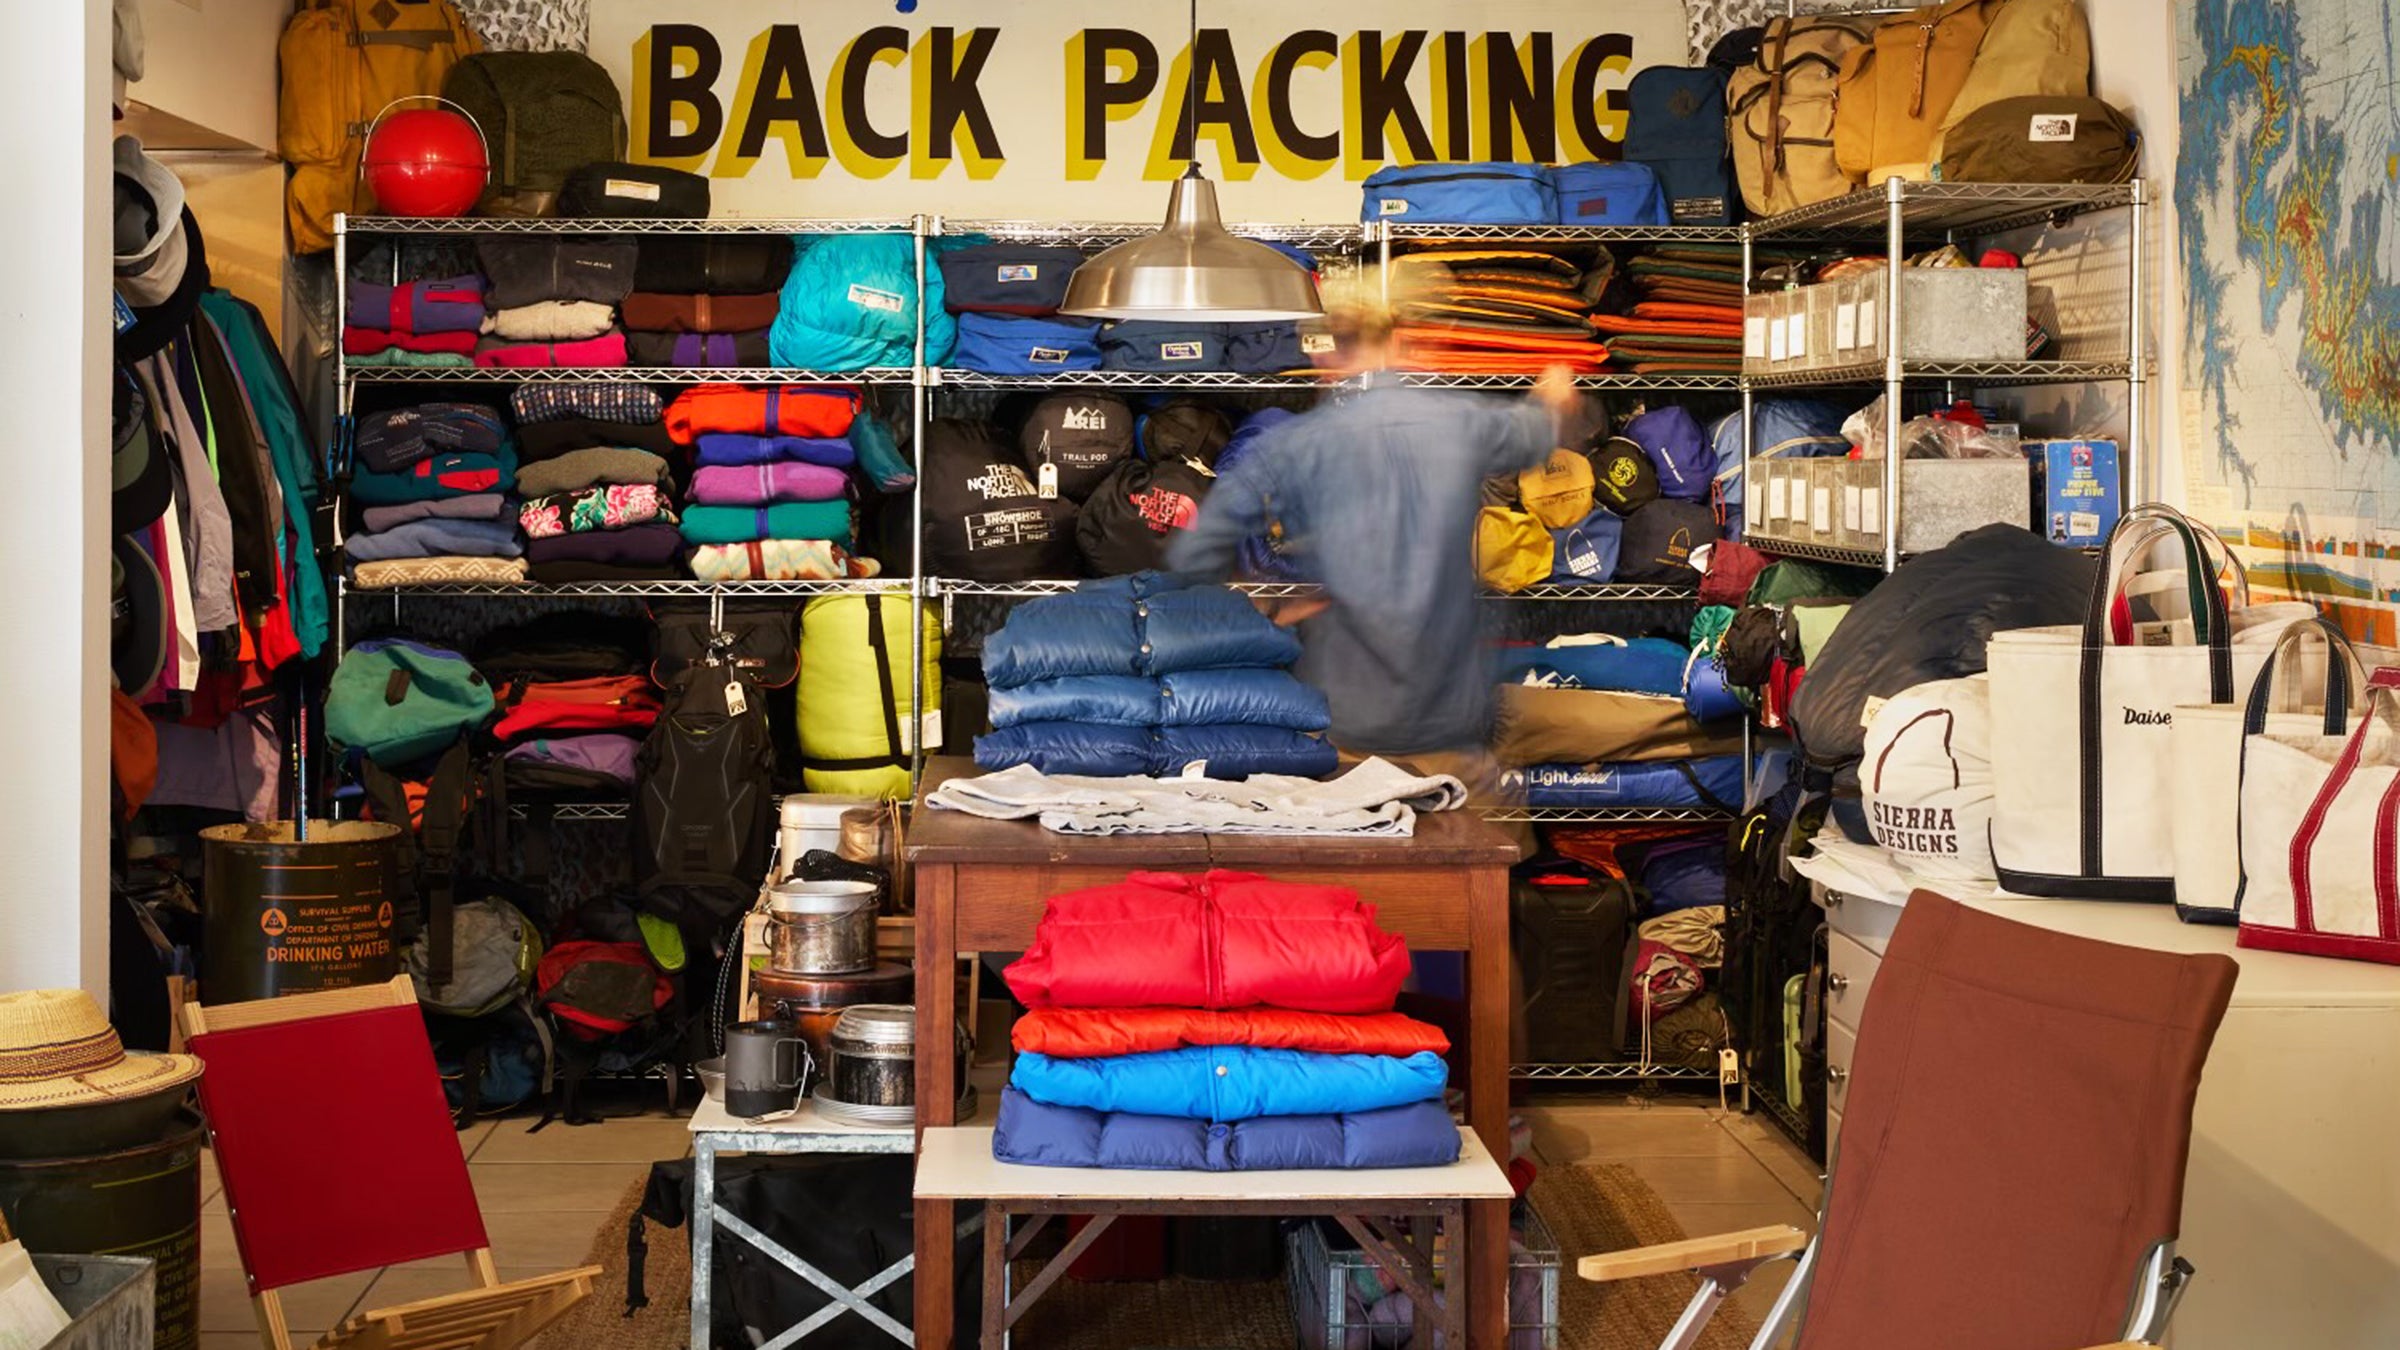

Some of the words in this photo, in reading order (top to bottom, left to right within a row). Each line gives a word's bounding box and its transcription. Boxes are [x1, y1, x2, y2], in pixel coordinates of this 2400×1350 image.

[642, 24, 1005, 164] BACK
[1078, 27, 1634, 166] PACKING
[1079, 416, 1106, 430] REI
[1063, 452, 1088, 461] TRAIL
[1090, 453, 1109, 461] POD
[985, 464, 1012, 476] THE
[967, 474, 1014, 492] NORTH
[983, 486, 1017, 499] FACE
[1152, 487, 1179, 503] THE
[1129, 494, 1177, 517] NORTH
[1138, 506, 1173, 524] FACE
[1873, 801, 1956, 831] SIERRA
[1876, 825, 1959, 853] DESIGNS
[266, 946, 344, 963] DRINKING
[348, 939, 391, 959] WATER
